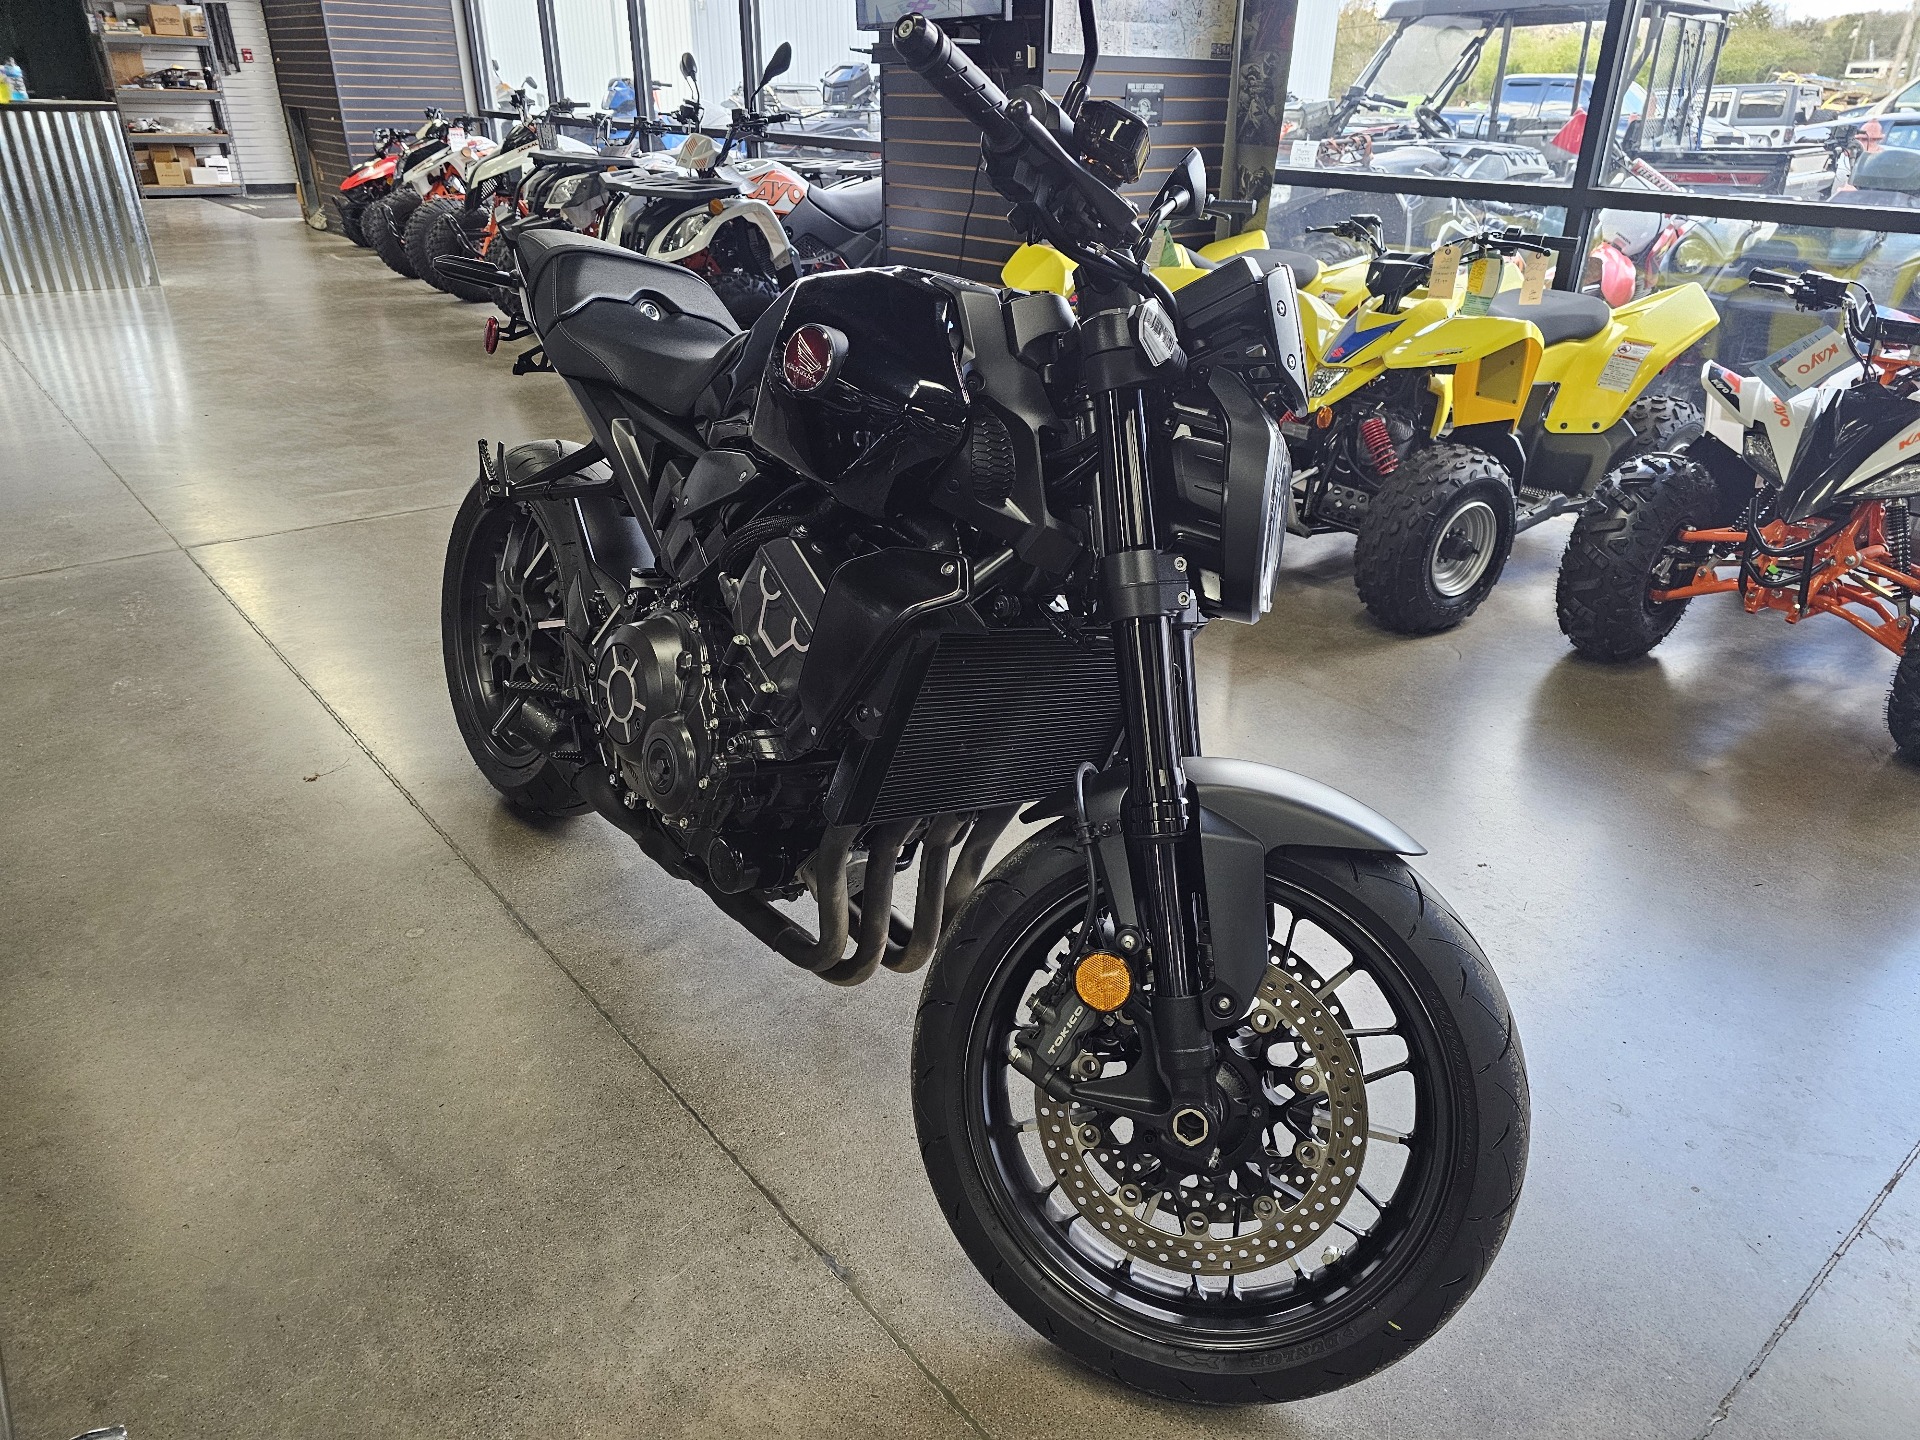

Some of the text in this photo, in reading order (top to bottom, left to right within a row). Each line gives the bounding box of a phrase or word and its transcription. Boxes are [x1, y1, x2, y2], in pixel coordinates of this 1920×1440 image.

[517, 142, 539, 153] JACKAL
[1635, 164, 1678, 192] RENTH
[1797, 342, 1840, 375] KAYO
[1048, 1005, 1083, 1054] TOKICO
